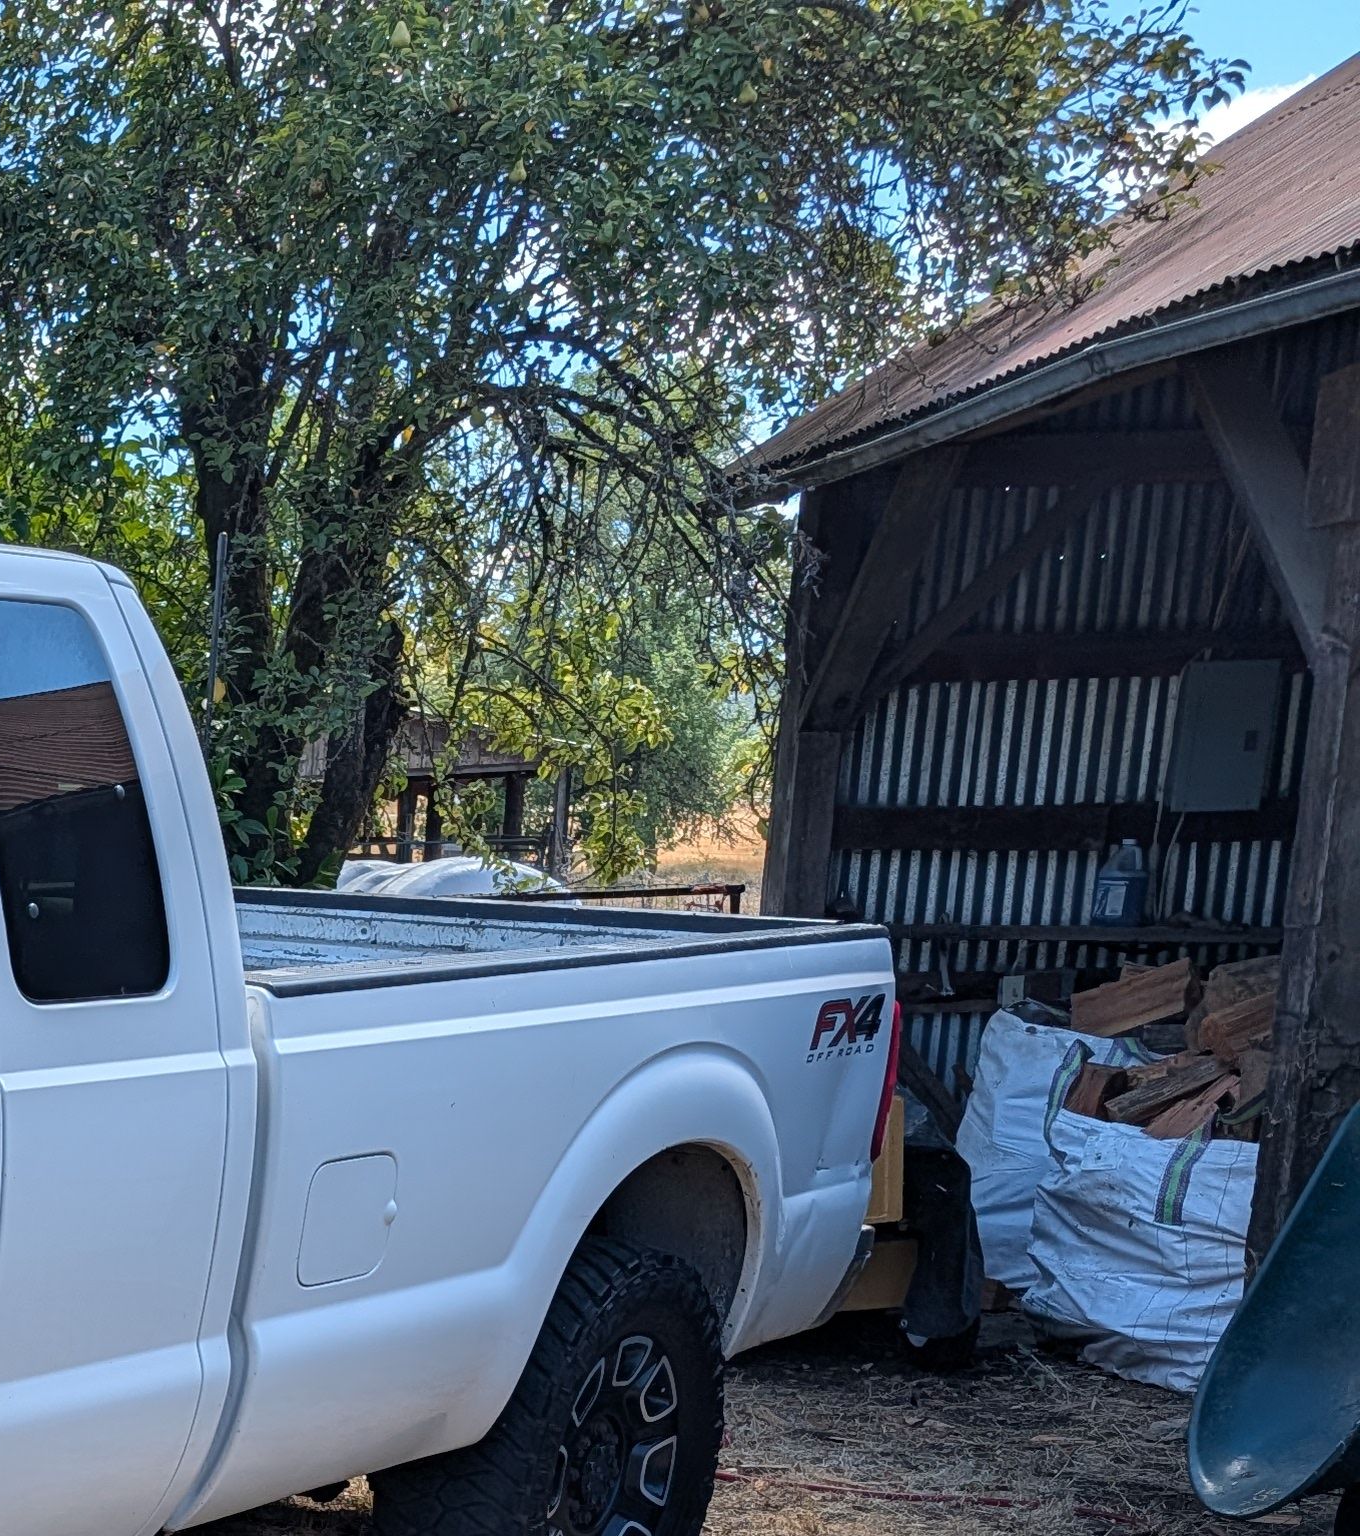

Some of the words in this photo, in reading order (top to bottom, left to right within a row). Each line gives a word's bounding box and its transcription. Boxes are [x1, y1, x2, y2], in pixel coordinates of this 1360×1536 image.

[809, 994, 886, 1050] FX4
[806, 1051, 833, 1064] OFF
[836, 1044, 874, 1058] ROAD
